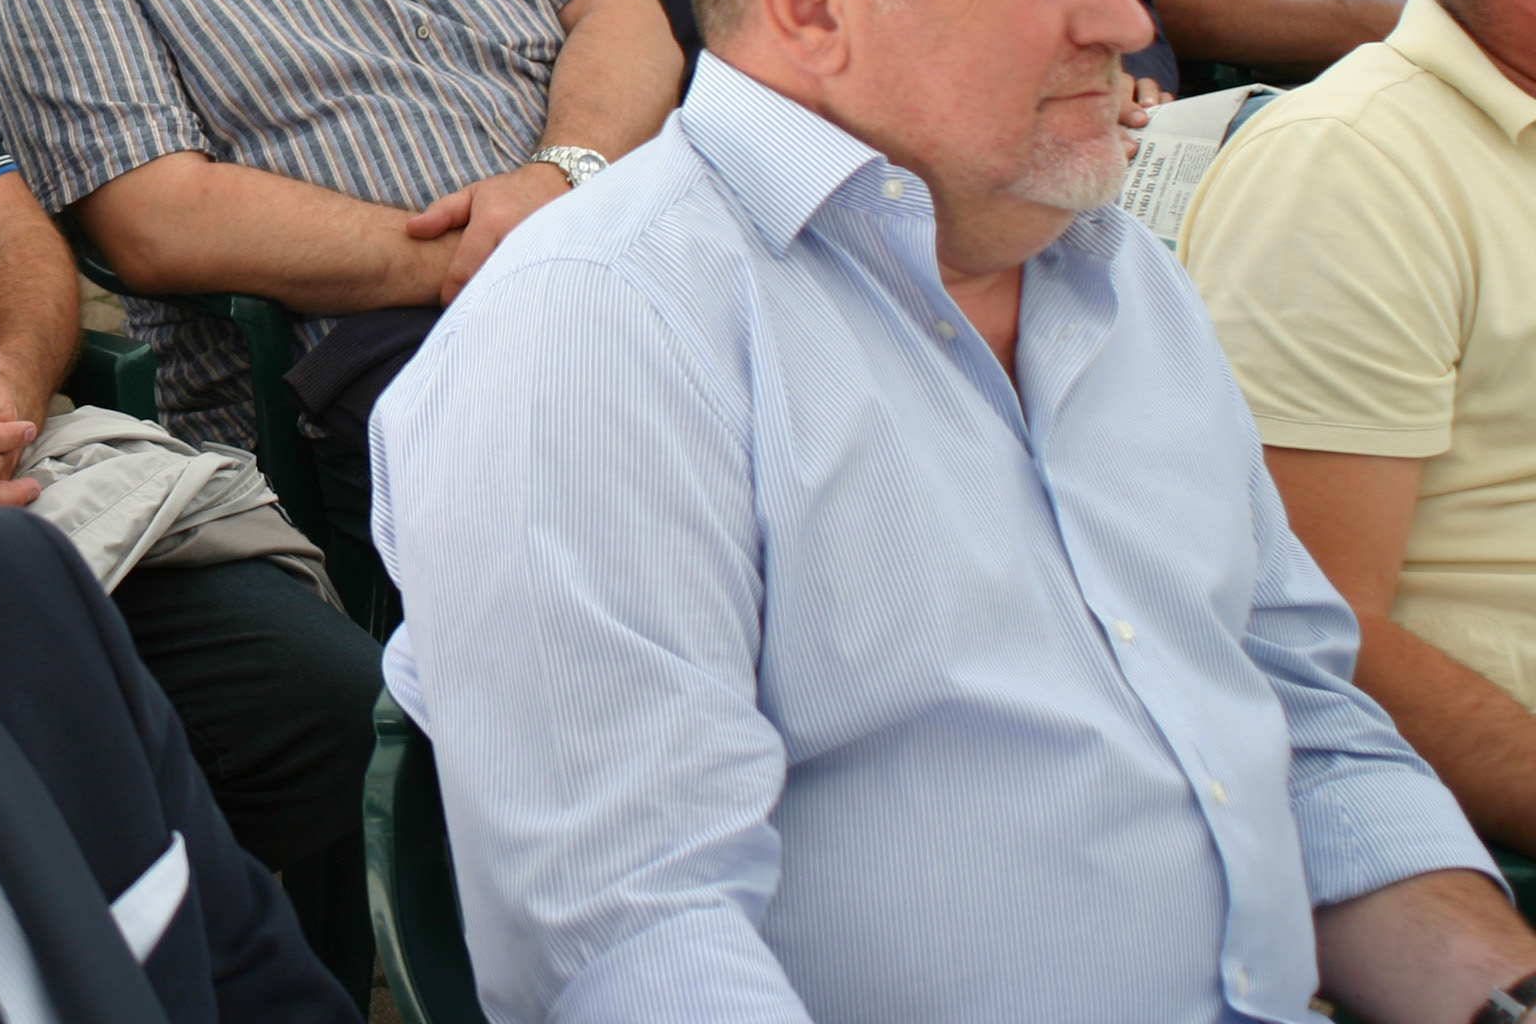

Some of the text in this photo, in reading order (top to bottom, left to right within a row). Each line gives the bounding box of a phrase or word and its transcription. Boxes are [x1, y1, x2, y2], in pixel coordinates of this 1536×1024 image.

[1131, 168, 1145, 188] non
[1138, 142, 1155, 167] temo
[1146, 157, 1165, 179] Aula
[1141, 182, 1156, 193] in
[1137, 194, 1151, 217] voto
